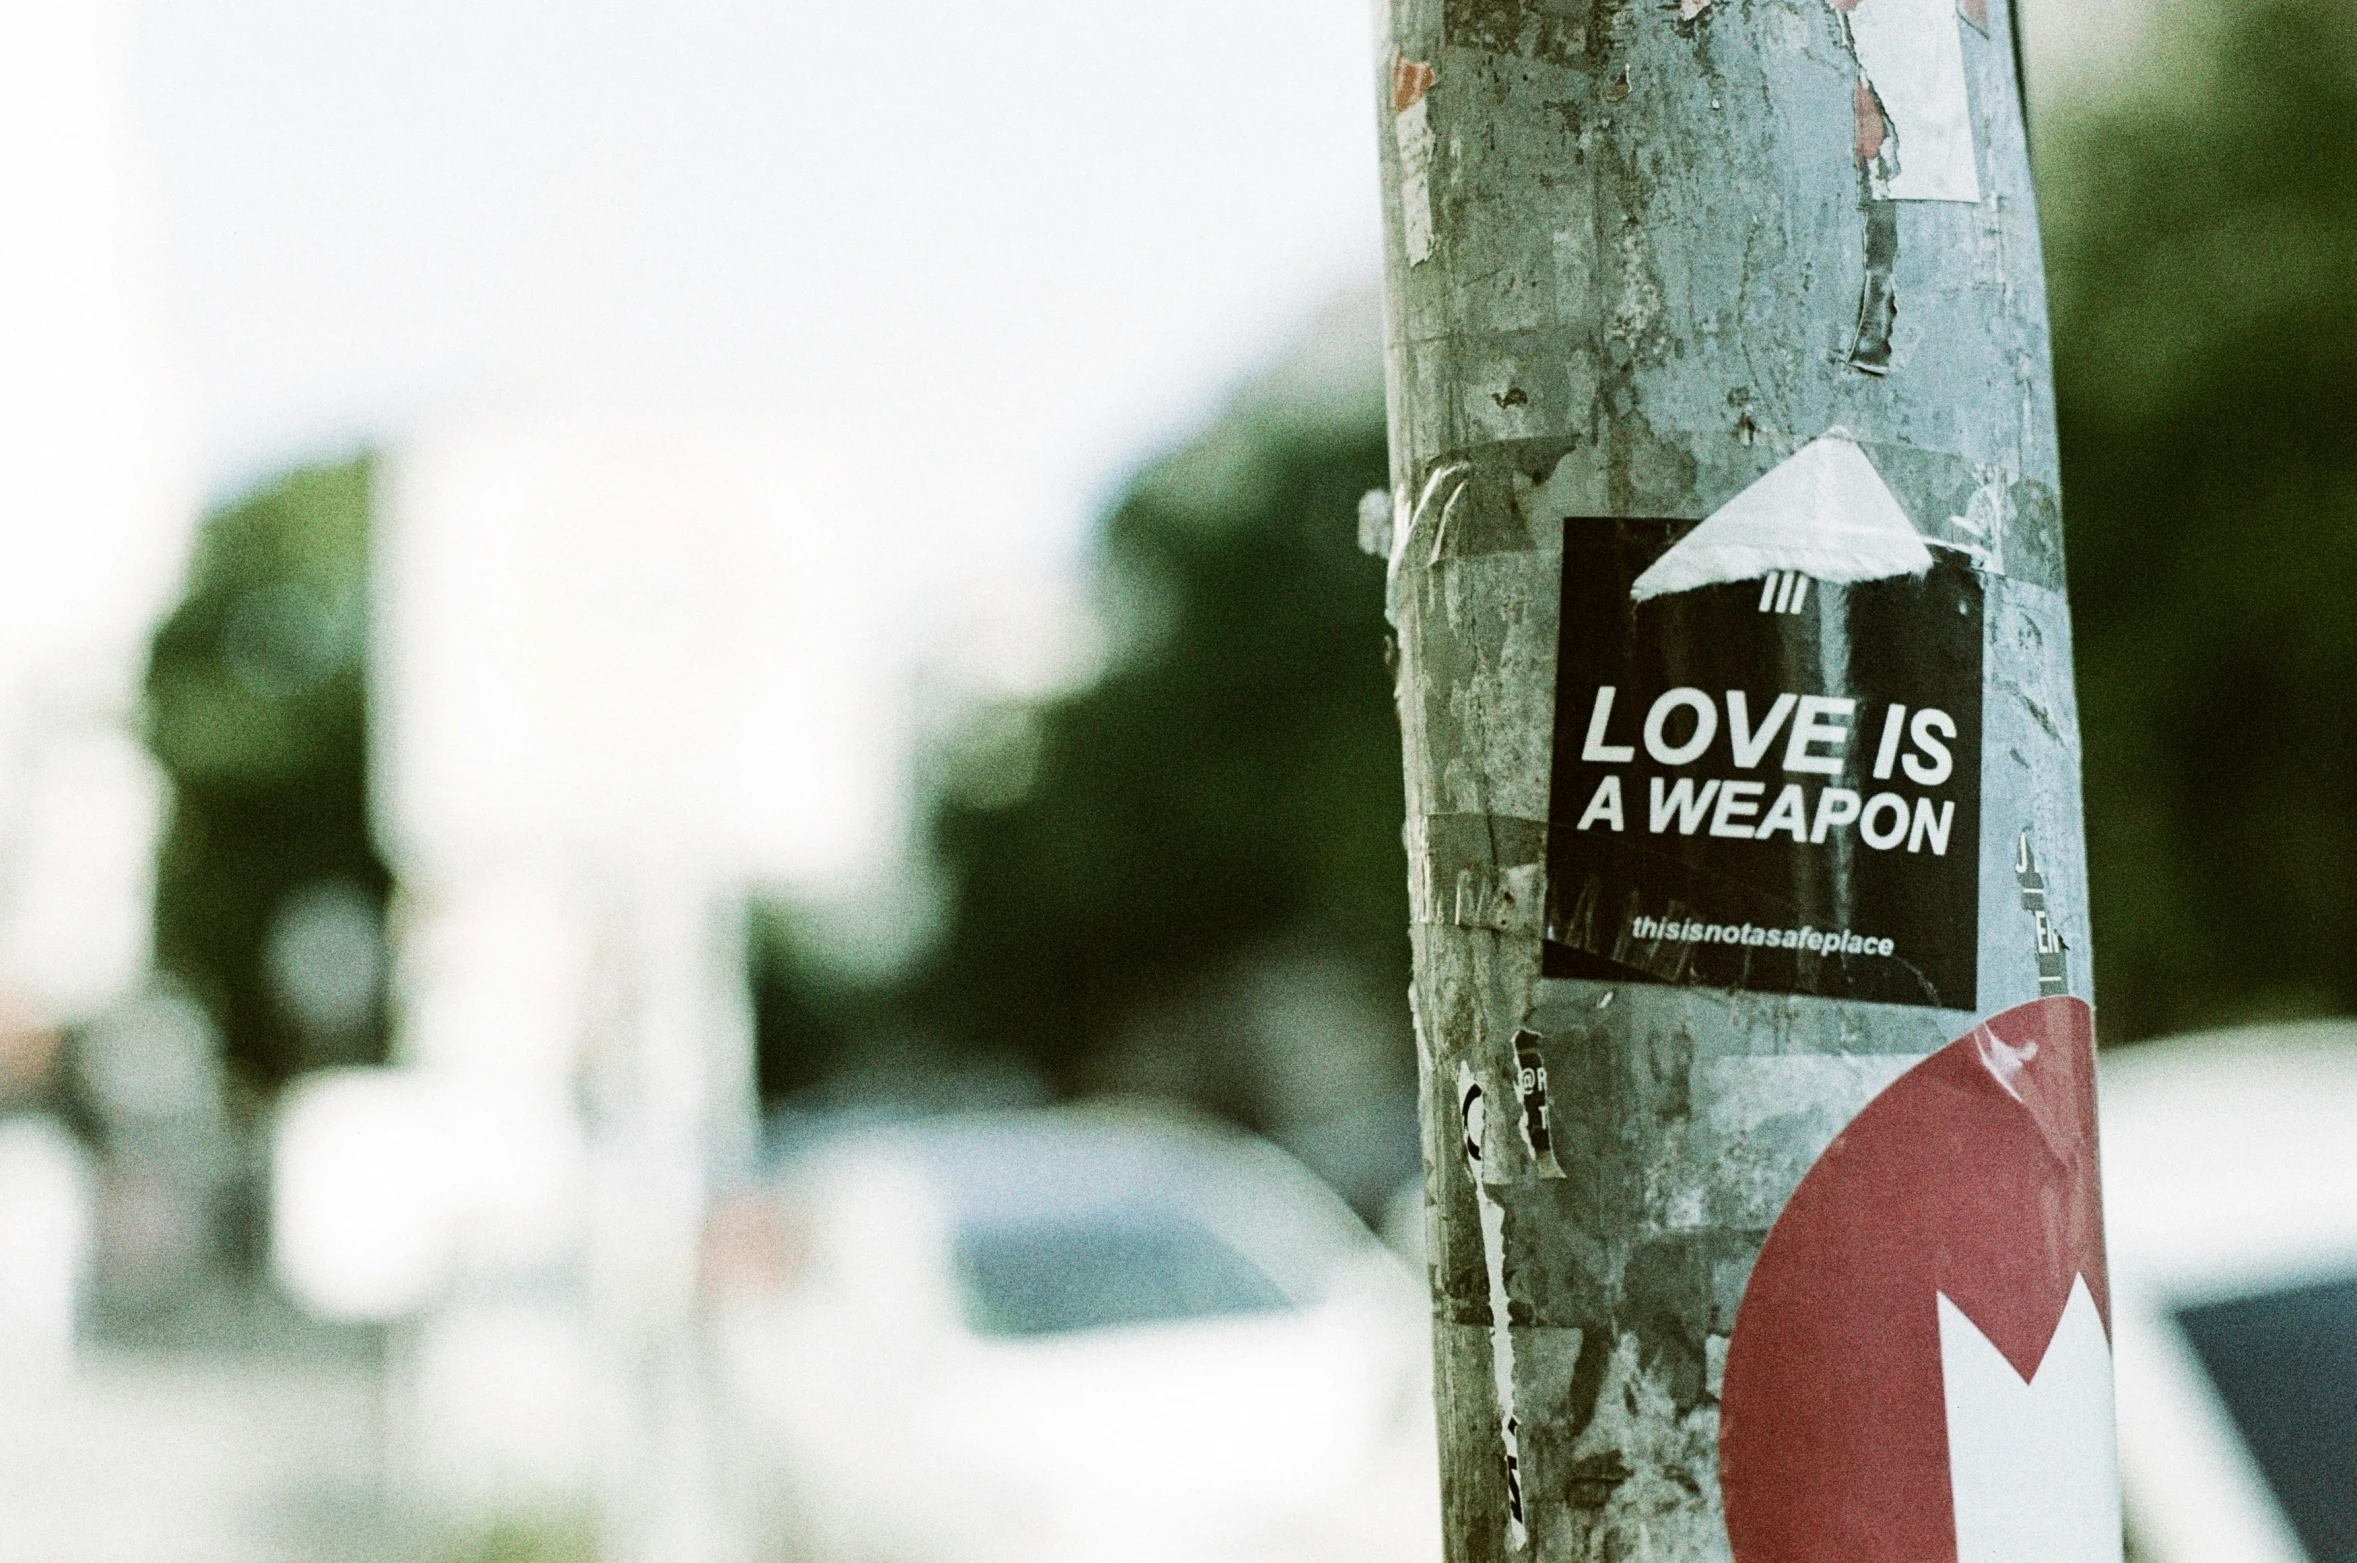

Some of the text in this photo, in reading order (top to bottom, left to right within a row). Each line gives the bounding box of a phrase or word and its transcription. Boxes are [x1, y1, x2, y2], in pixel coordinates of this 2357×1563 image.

[1581, 686, 1958, 786] LOVE IS
[1577, 775, 1955, 856] A WEAPON
[1632, 916, 1895, 957] thisisnotasafeplace
